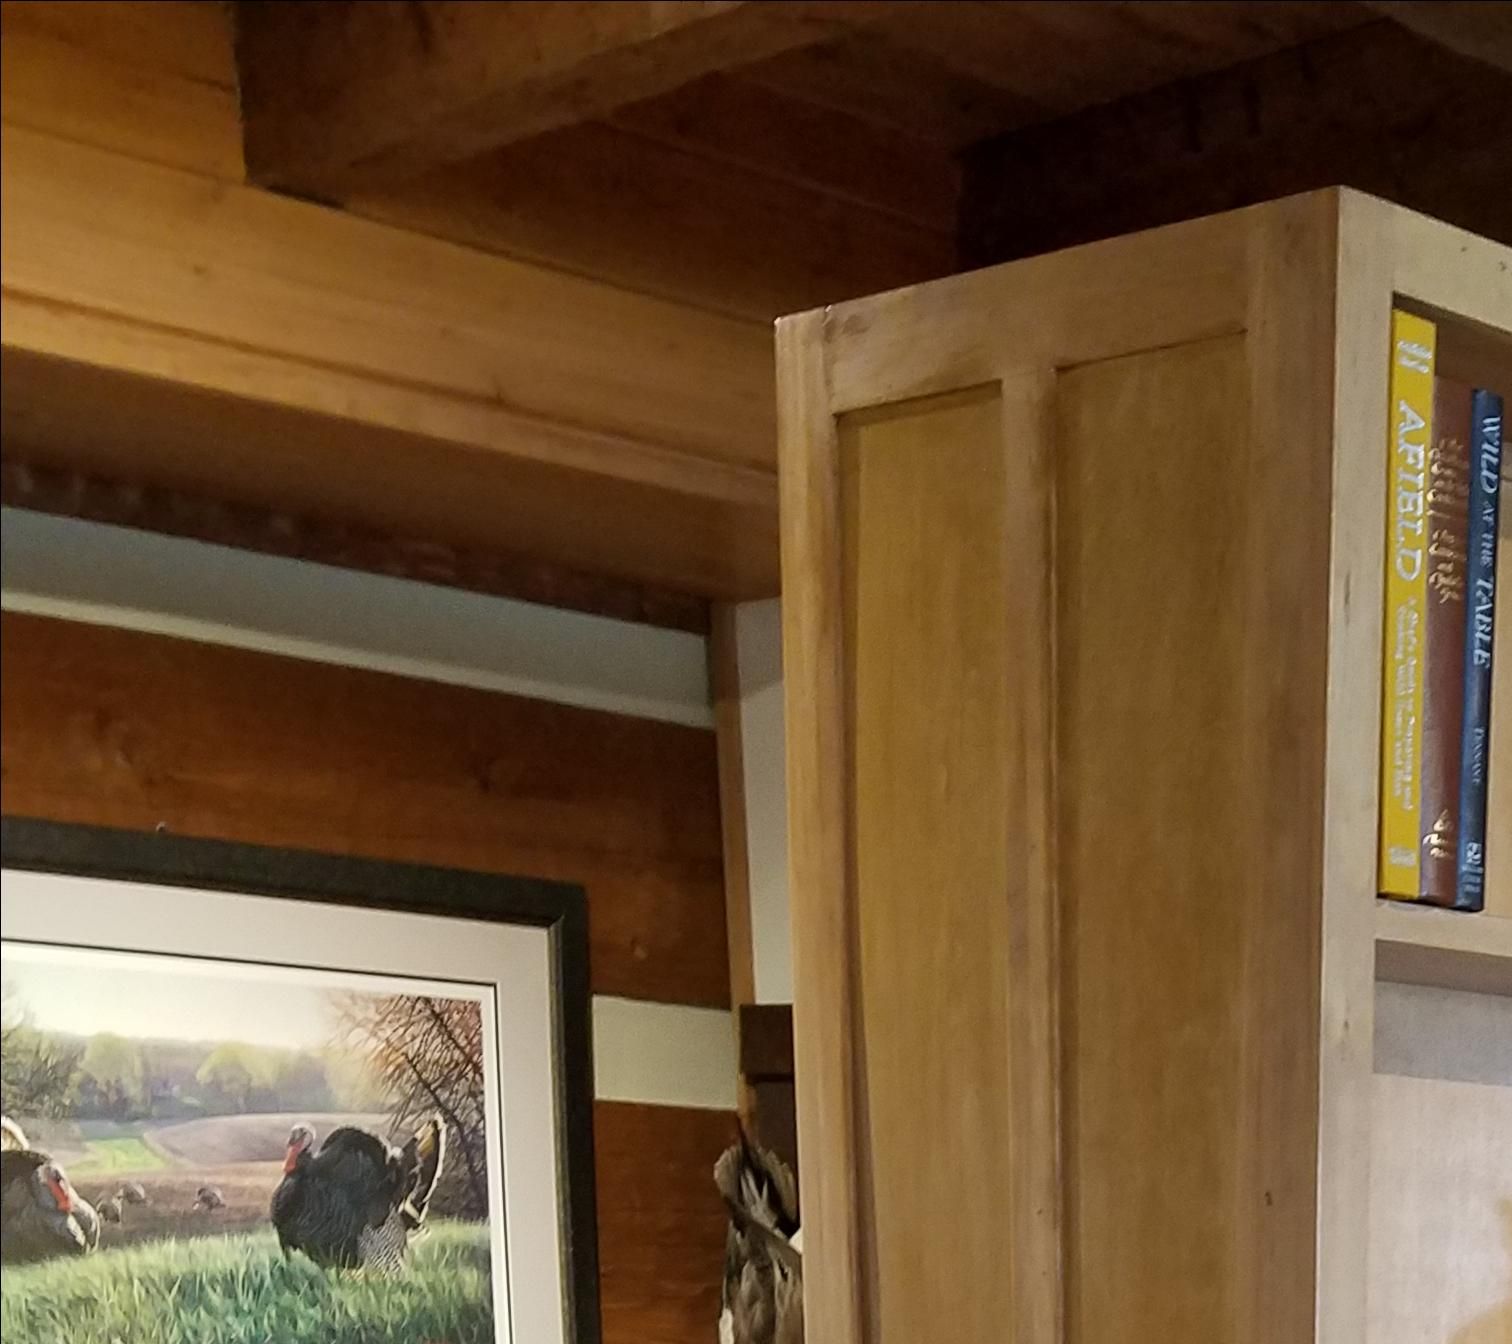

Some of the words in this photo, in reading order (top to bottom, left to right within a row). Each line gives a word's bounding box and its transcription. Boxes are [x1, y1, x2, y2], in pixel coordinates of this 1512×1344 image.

[1396, 399, 1425, 581] AFIELD
[1480, 416, 1500, 494] WILD
[1481, 501, 1495, 522] AT
[1473, 578, 1495, 669] TABLE
